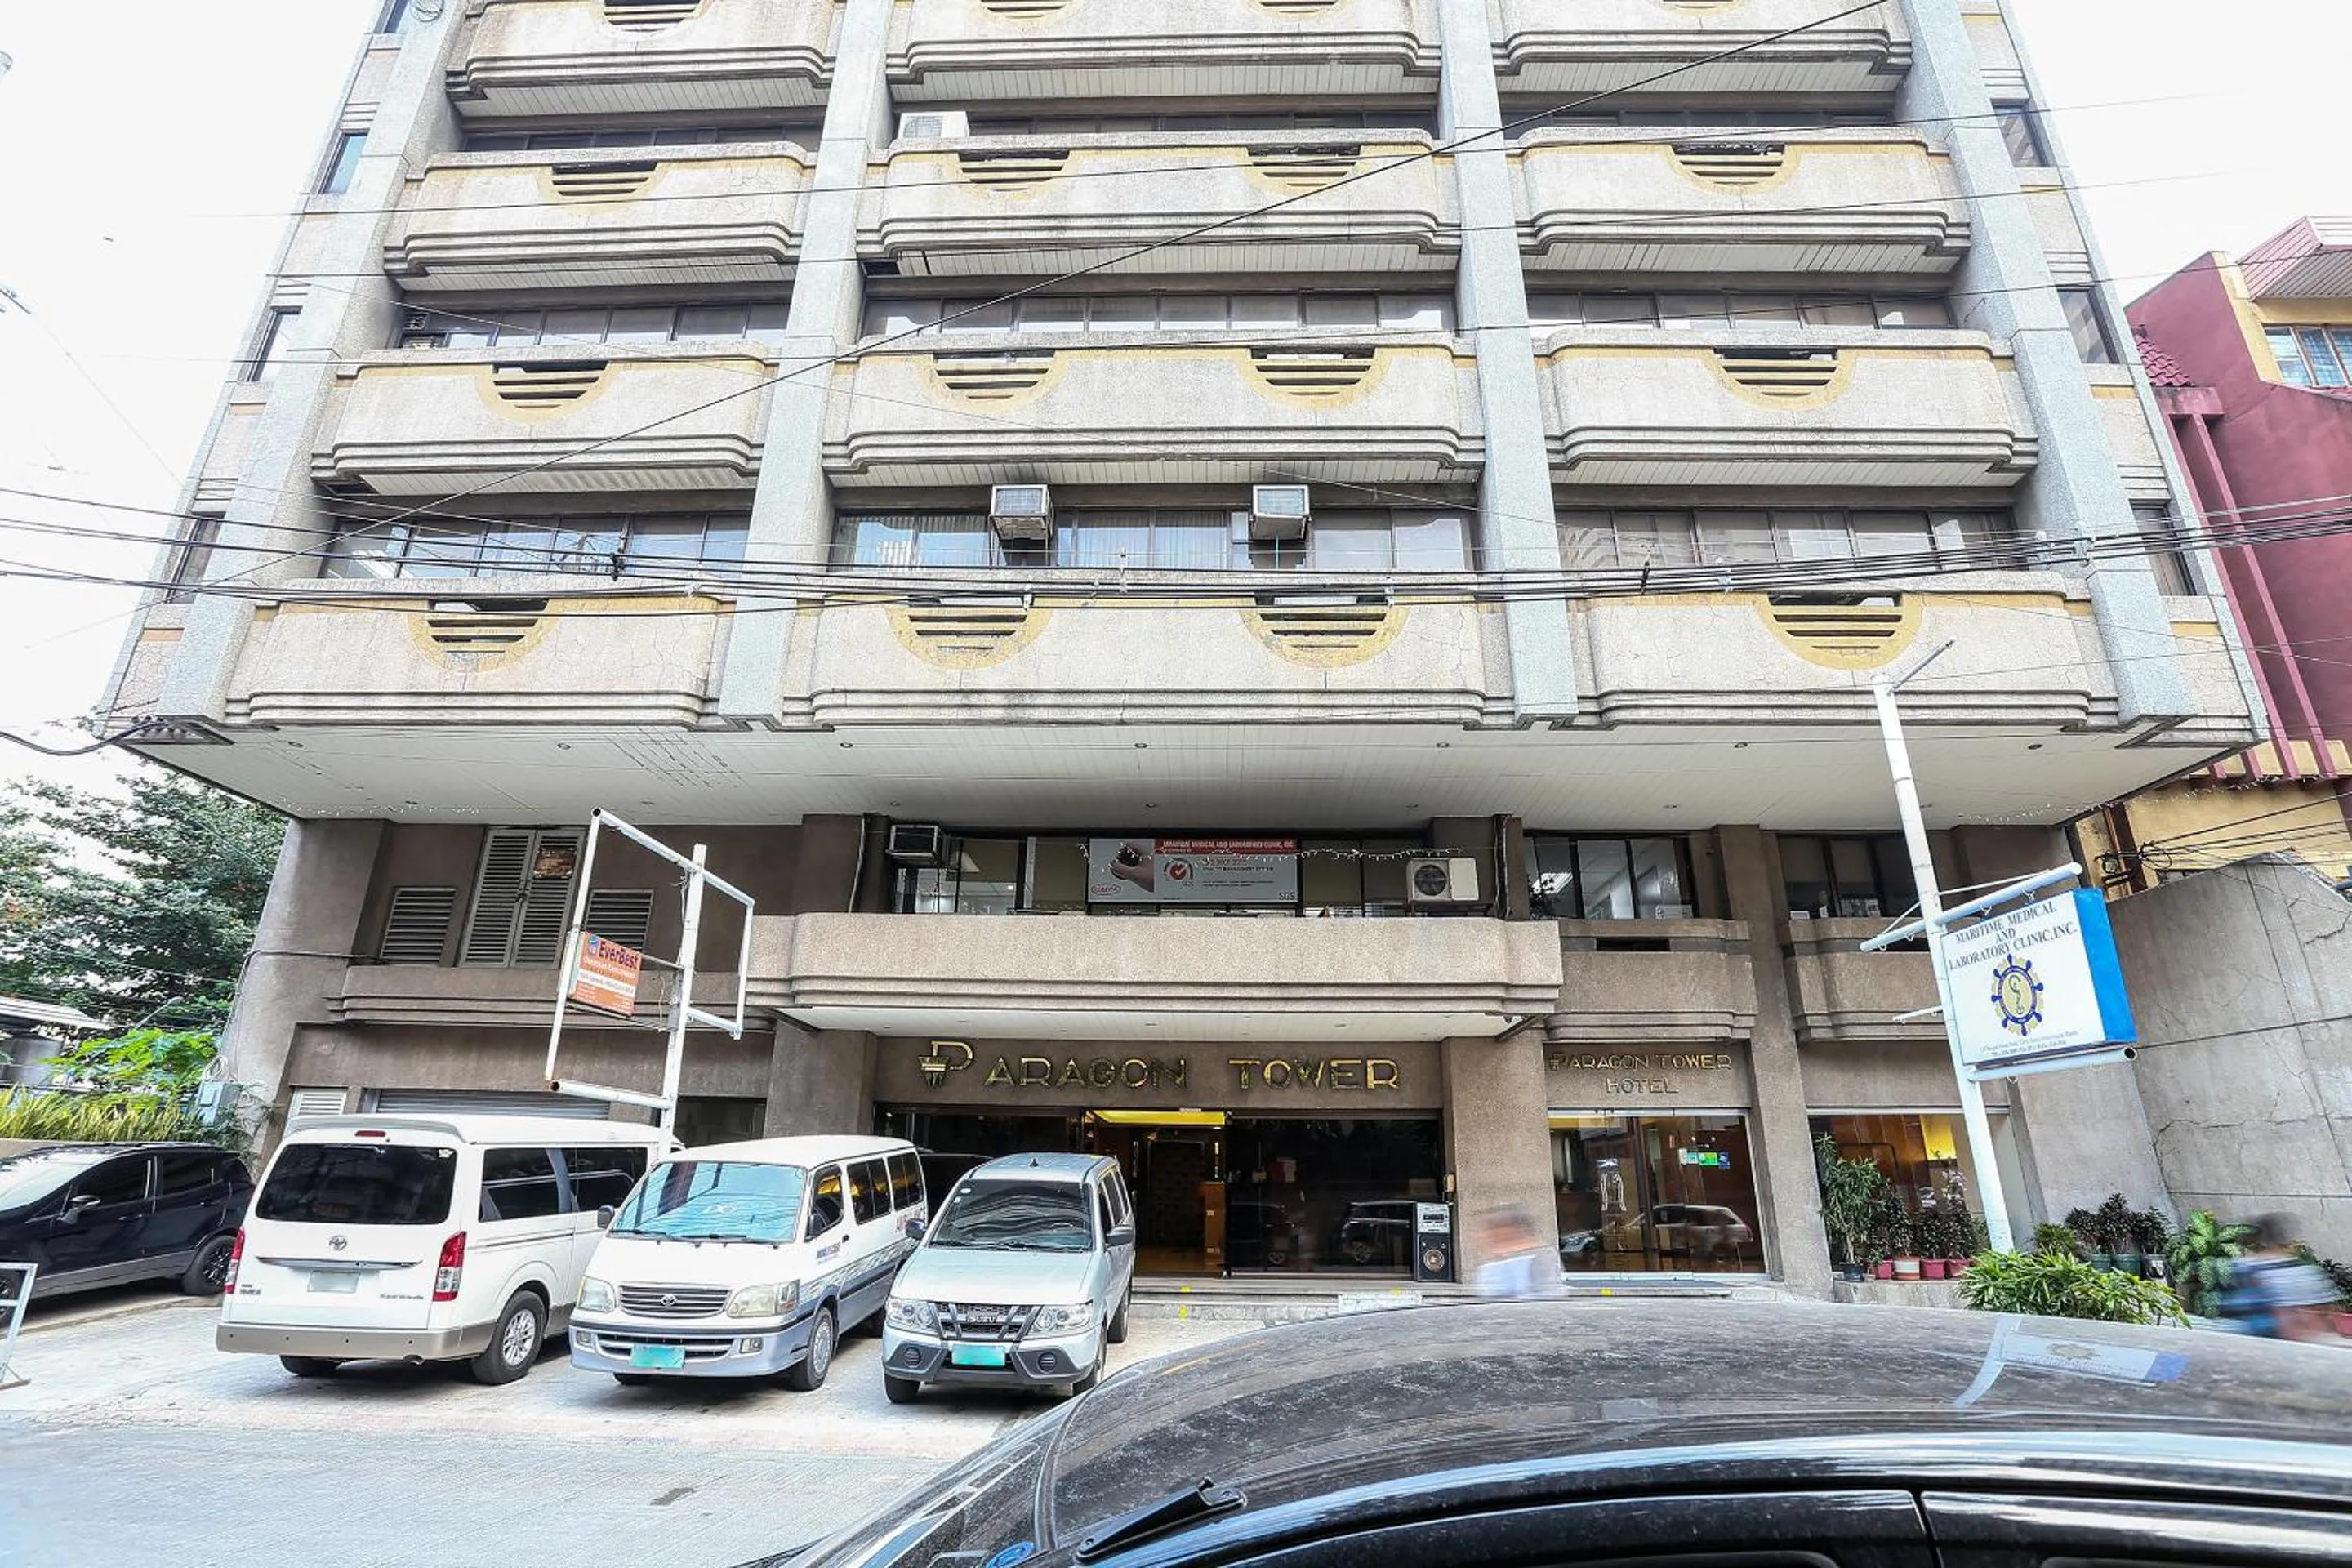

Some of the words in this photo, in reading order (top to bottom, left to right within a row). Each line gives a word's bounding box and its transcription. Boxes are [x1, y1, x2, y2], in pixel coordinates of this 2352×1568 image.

[1956, 919, 2004, 943] MARITIME
[2007, 902, 2056, 924] MEDICAL
[1996, 928, 2016, 944] AND
[599, 941, 638, 969] EverBest
[1949, 945, 2010, 970] LABORATORY
[932, 1040, 1187, 1089] PARAGON
[1228, 1058, 1400, 1089] TOWER
[1552, 1053, 1649, 1071] PARAGON
[1655, 1054, 1732, 1070] TOWER
[1605, 1078, 1679, 1094] HOTEL
